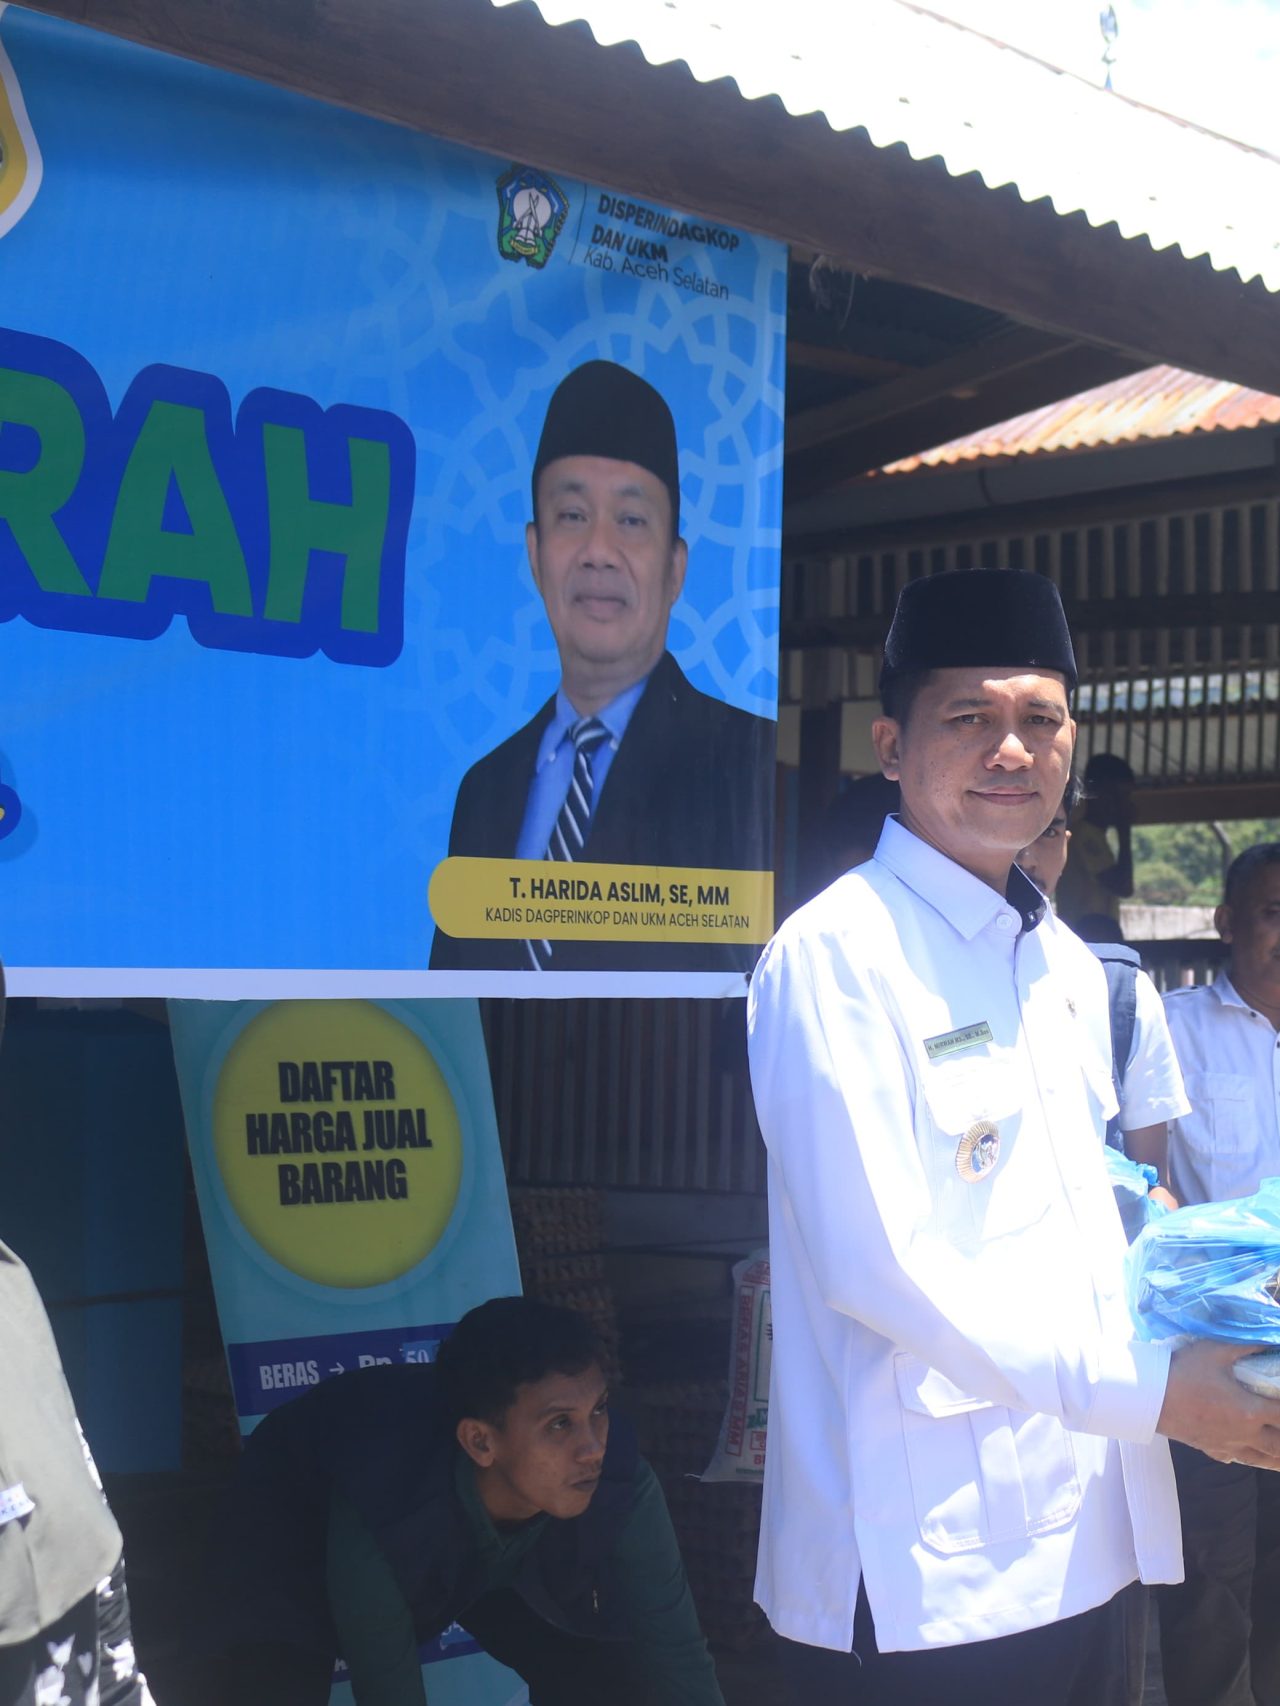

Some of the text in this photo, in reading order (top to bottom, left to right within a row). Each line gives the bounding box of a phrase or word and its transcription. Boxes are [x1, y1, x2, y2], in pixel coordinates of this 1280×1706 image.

[591, 224, 669, 263] DAN UKM
[597, 194, 740, 251] DISPERINDAGKOP
[584, 245, 729, 300] Kab. Aceh Selatan
[510, 877, 730, 907] T. HARIDA ASLIM, SE, MM
[486, 907, 750, 928] KADIS DAGPERINKOP DAN UKM ACEH SELATAN
[278, 1061, 395, 1103] DAFTAR
[246, 1108, 432, 1155] HARGA JUAL
[278, 1158, 408, 1206] BARANG
[259, 1360, 320, 1390] BERAS
